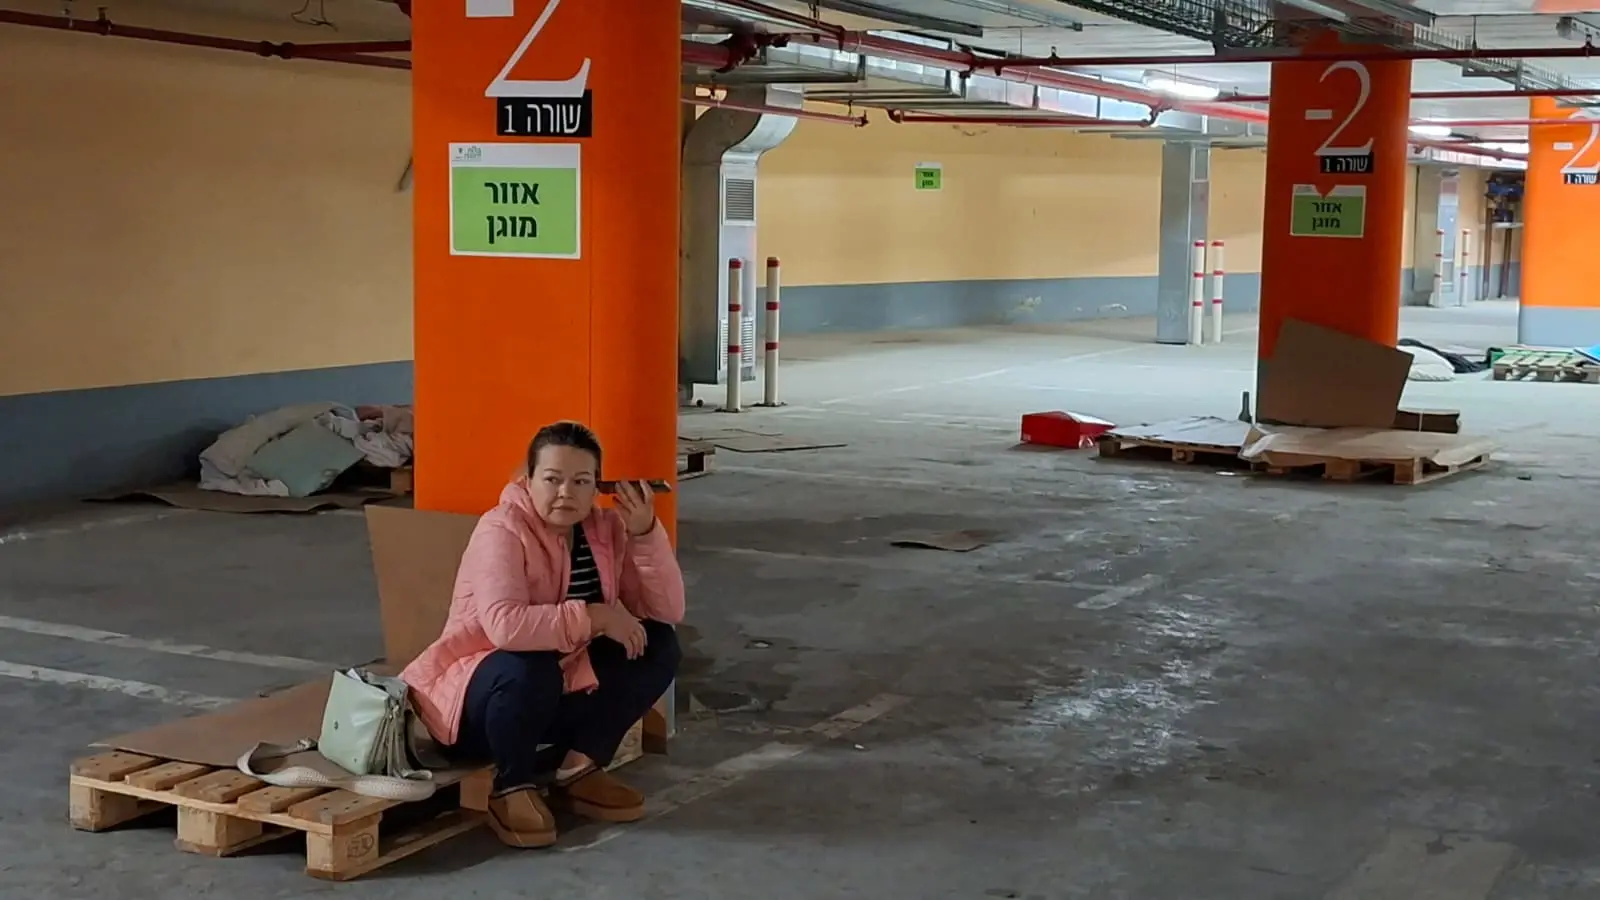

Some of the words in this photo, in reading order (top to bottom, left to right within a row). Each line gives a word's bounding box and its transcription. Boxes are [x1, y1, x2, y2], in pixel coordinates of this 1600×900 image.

[503, 104, 517, 133] 1
[526, 103, 582, 134] שורה
[1305, 60, 1374, 156] -2
[1336, 156, 1368, 172] שורה
[484, 182, 540, 205] אזור
[1312, 201, 1342, 214] אזור
[486, 215, 538, 245] מוגן
[1312, 216, 1341, 231] מוגן
